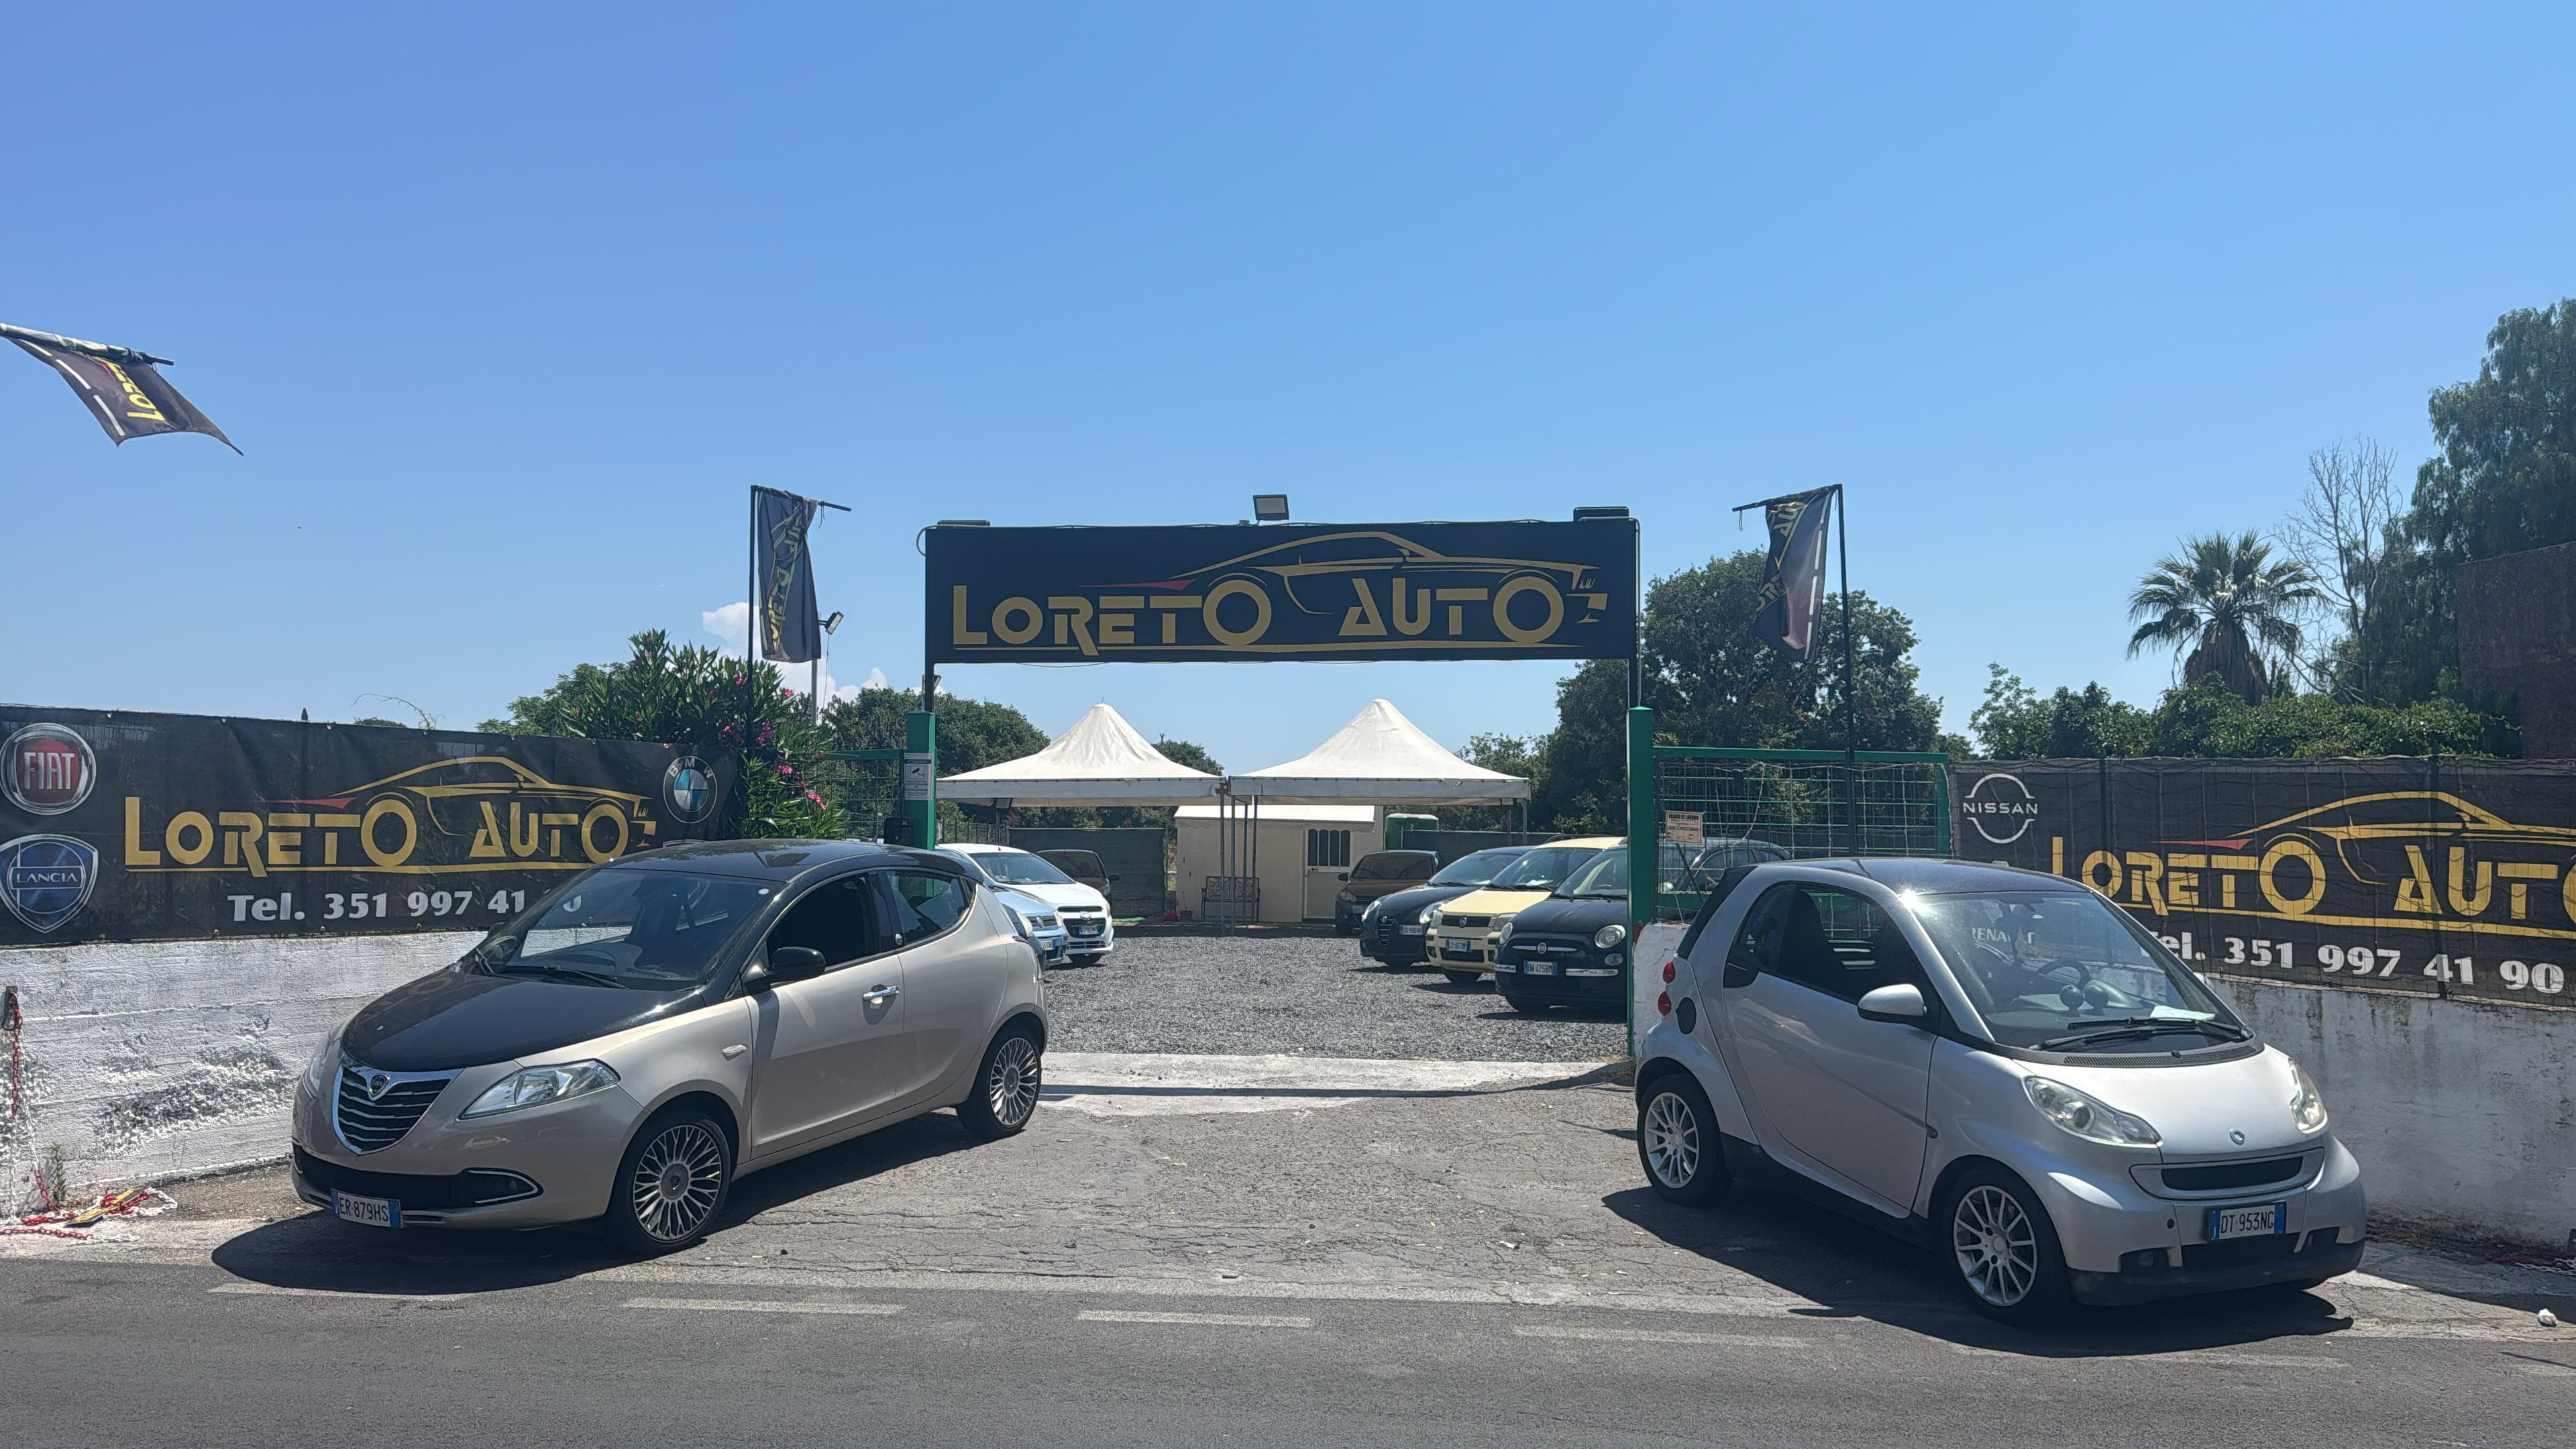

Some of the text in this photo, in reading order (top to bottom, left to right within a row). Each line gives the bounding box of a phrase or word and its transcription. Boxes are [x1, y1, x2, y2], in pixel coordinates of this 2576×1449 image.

[953, 576, 1564, 656] LORETO AUTO
[24, 751, 76, 790] FIAT
[669, 757, 714, 779] BMW
[1963, 802, 2038, 815] NISSAN
[125, 796, 629, 877] LORETO AUTO
[16, 873, 79, 885] LANCIA
[2394, 844, 2576, 927] AUT
[227, 892, 305, 922] Tel.
[323, 892, 387, 920] 351
[407, 890, 473, 917] 997
[488, 890, 525, 914] 41
[2223, 936, 2294, 969] 351
[2318, 944, 2401, 977] 997
[2423, 953, 2475, 985] 41
[2500, 959, 2565, 994] 90
[2221, 1214, 2236, 1234] DT
